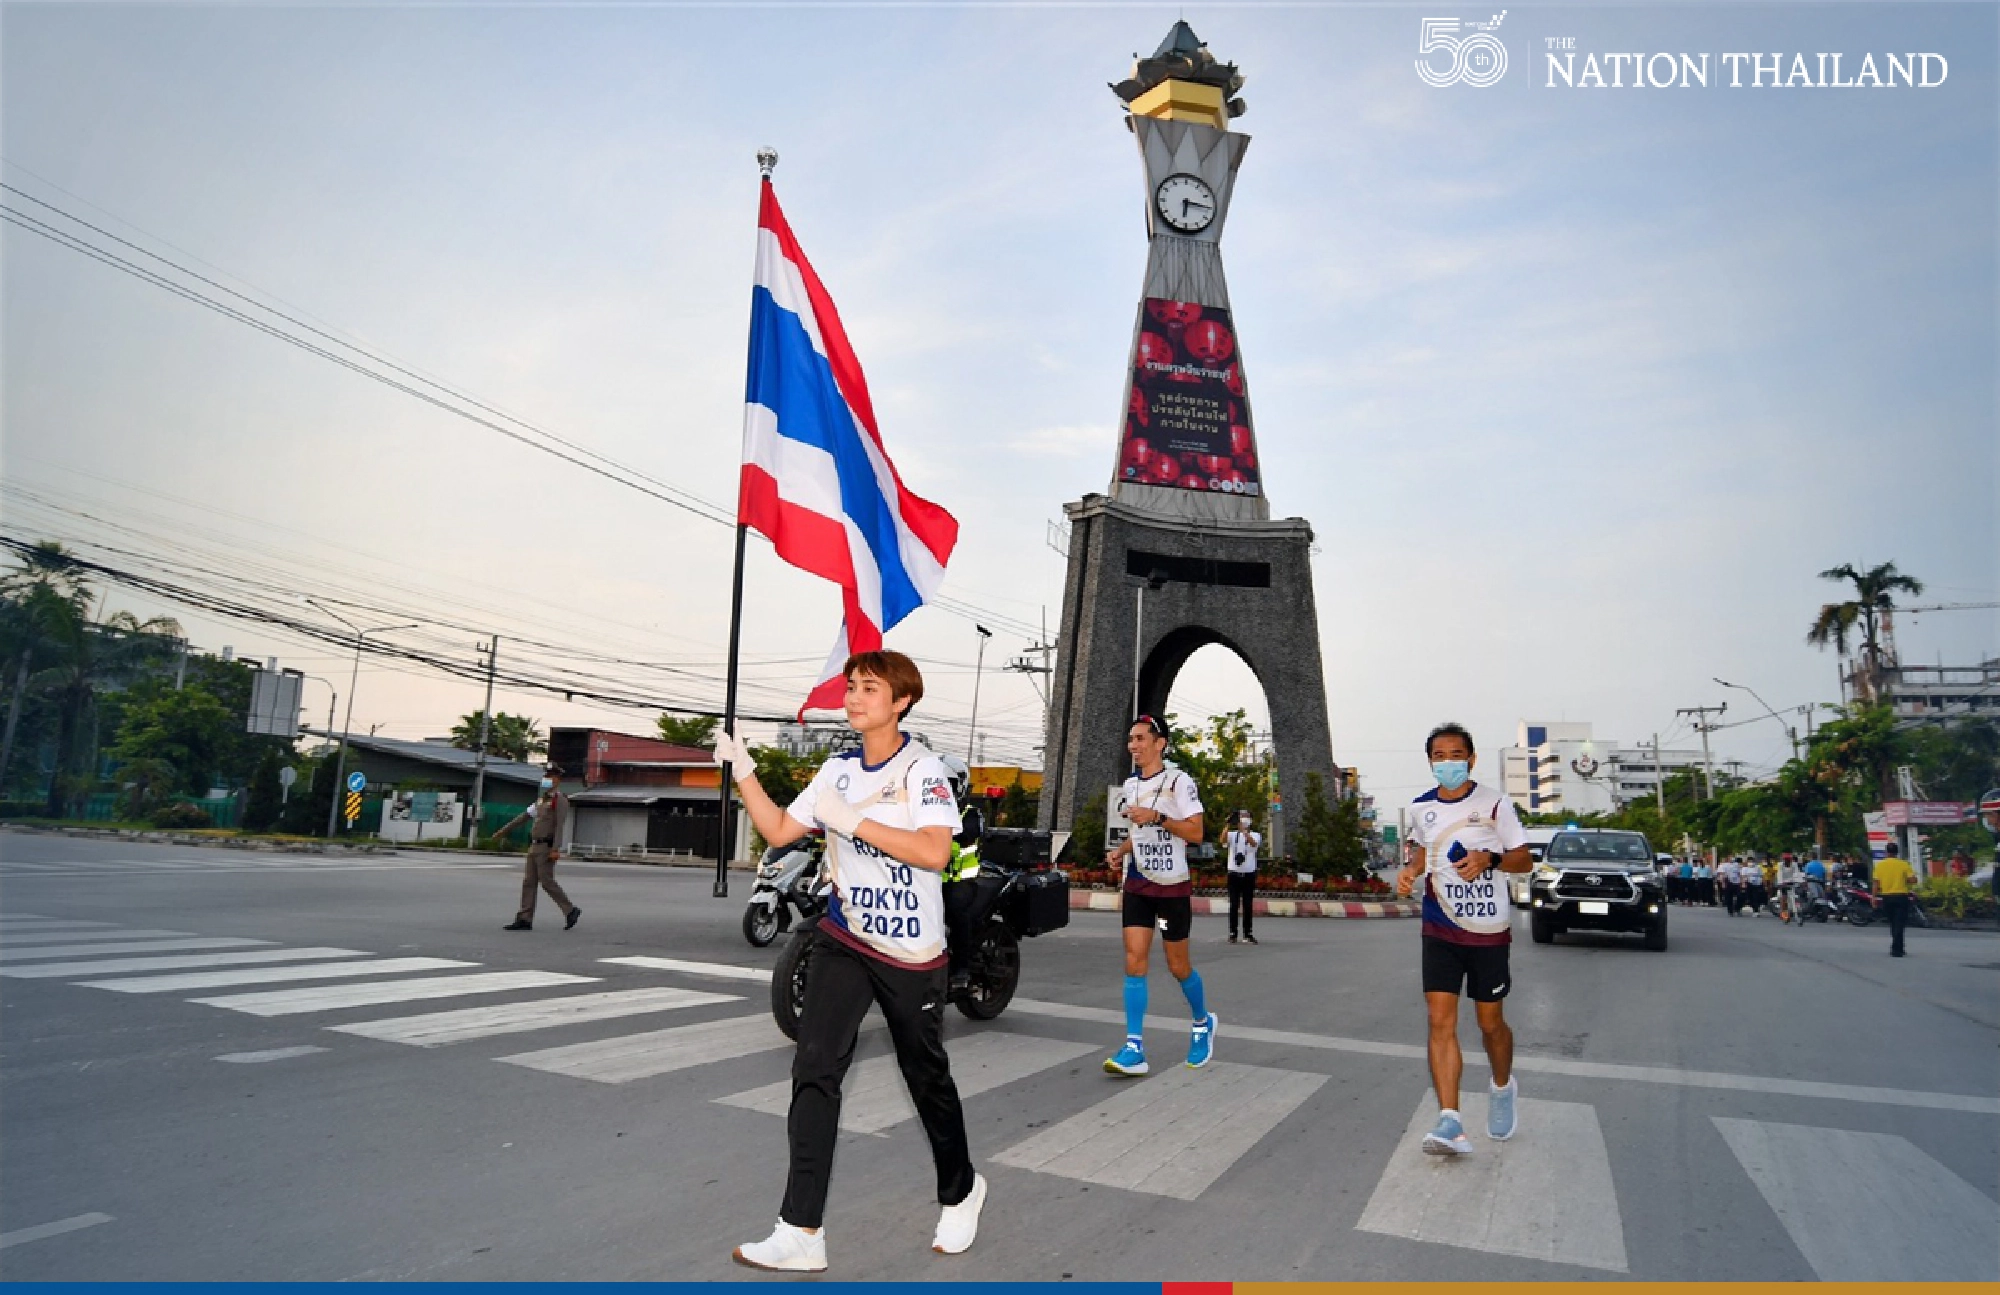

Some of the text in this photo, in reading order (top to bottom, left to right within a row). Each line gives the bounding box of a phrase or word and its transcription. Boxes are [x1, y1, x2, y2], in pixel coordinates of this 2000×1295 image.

[1137, 842, 1173, 857] TOKYO
[1144, 857, 1174, 872] 2020
[885, 863, 913, 887] TO
[849, 886, 919, 911] TOKYO
[1444, 883, 1494, 899] TOKYO
[1454, 901, 1498, 918] 2020
[861, 912, 921, 938] 2020
